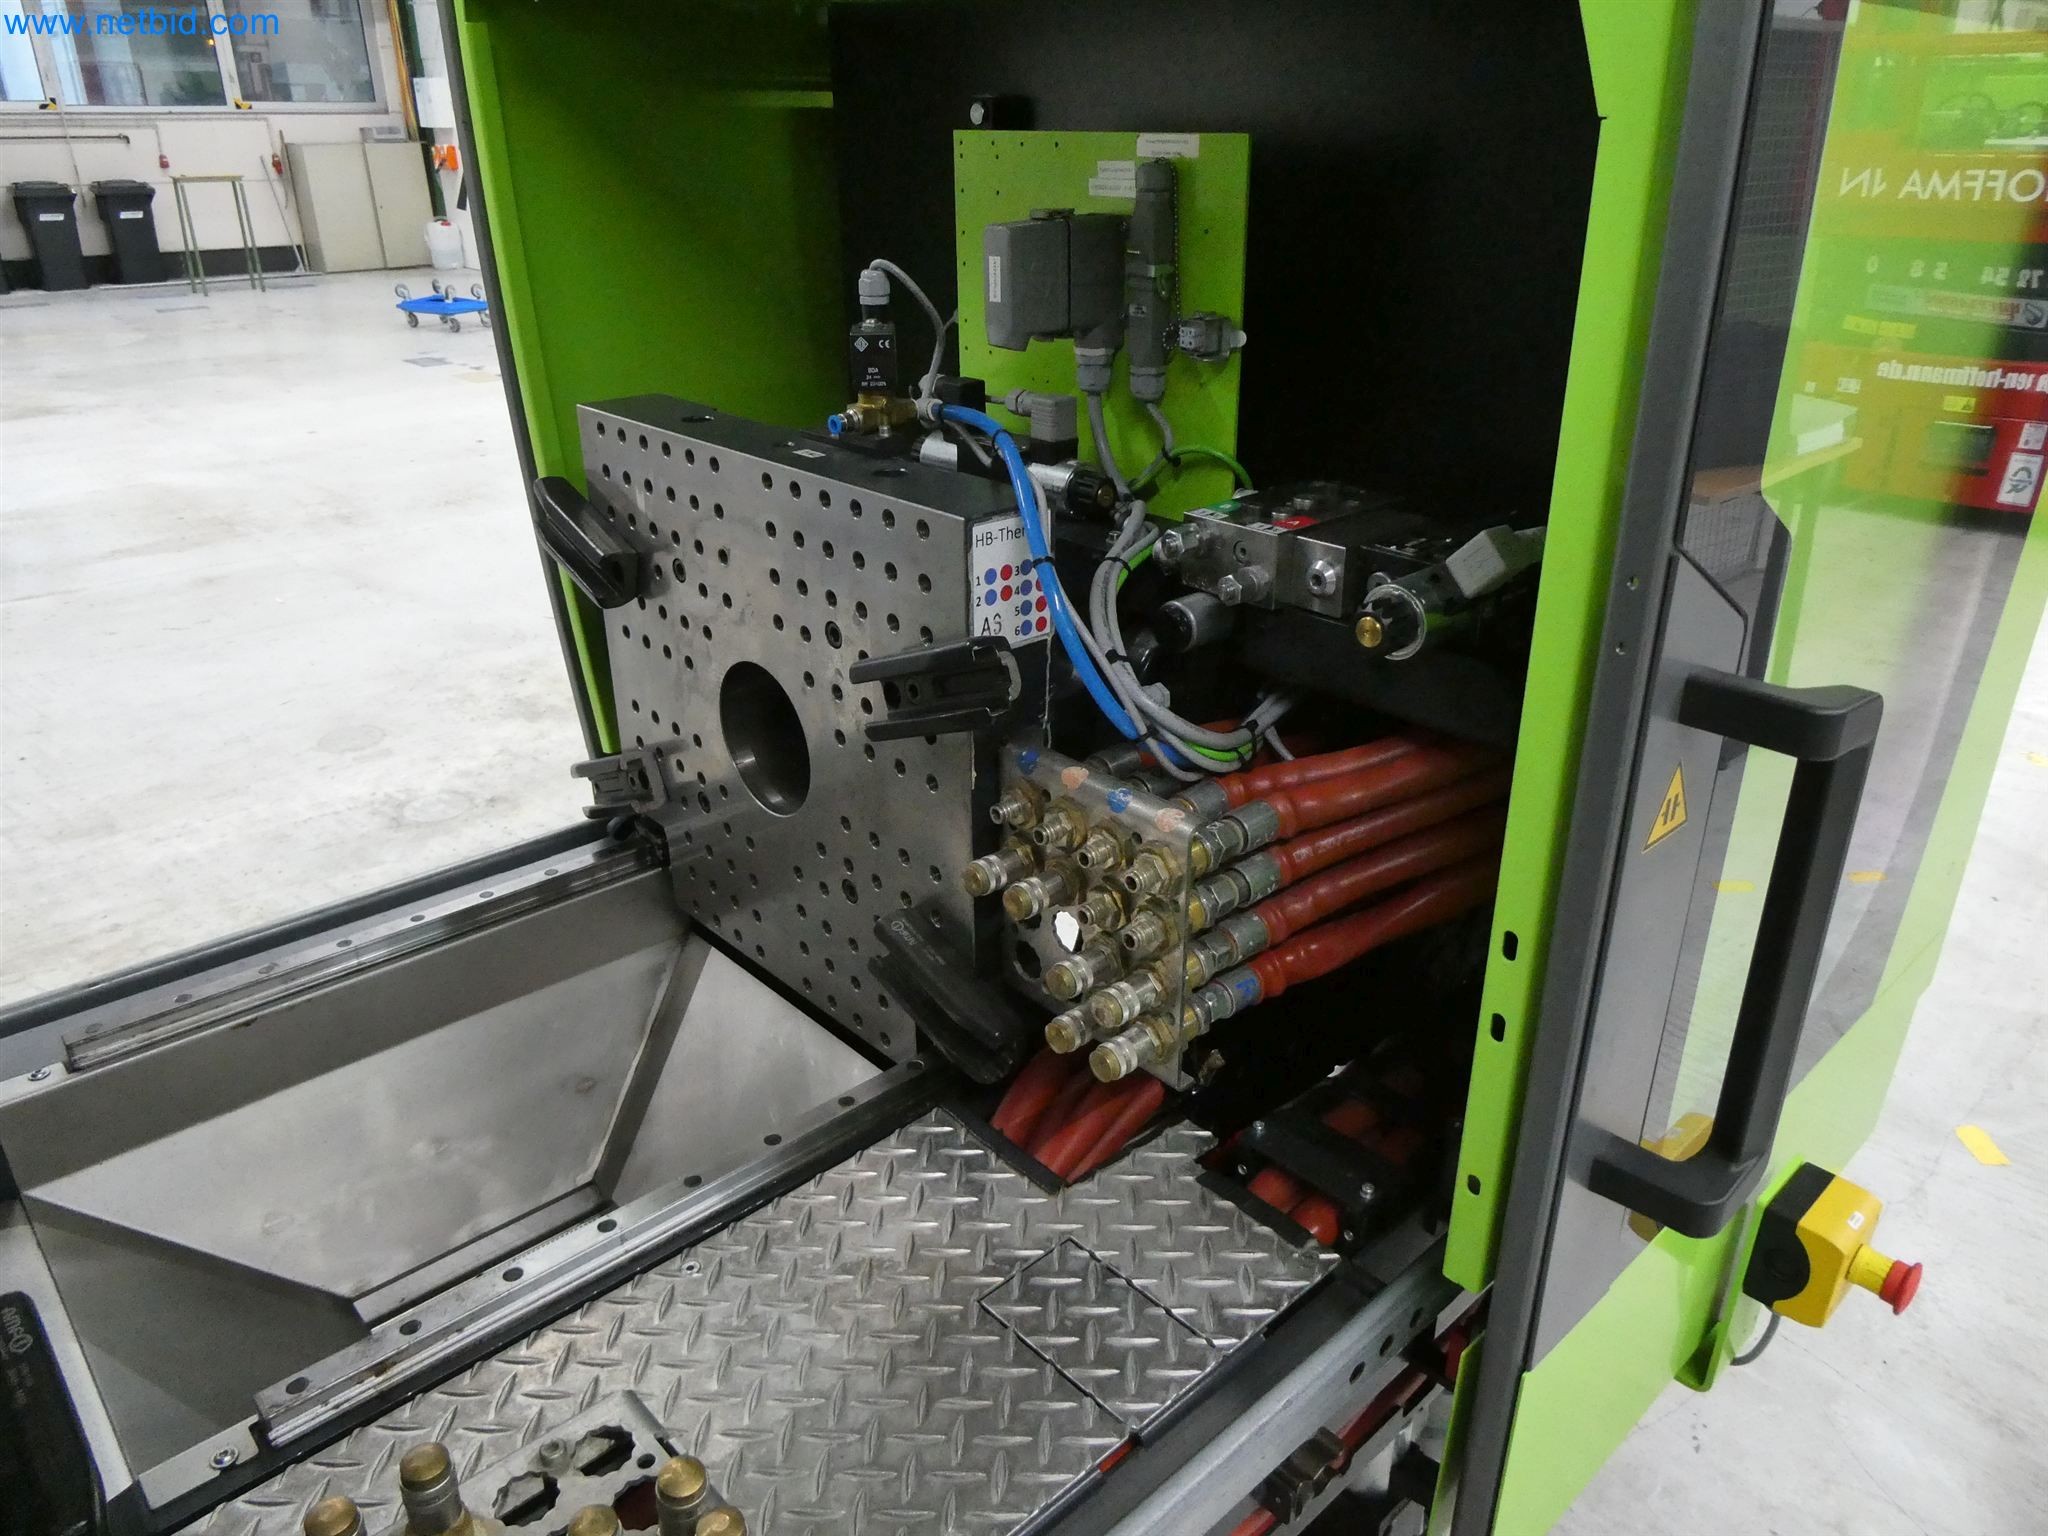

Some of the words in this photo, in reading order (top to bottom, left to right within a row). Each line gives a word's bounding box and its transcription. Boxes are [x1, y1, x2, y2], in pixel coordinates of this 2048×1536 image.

[1014, 565, 1020, 576] 3
[975, 576, 981, 586] 1
[1014, 585, 1020, 596] 4
[975, 597, 982, 607] 2
[1014, 606, 1020, 616] 5
[1014, 625, 1020, 636] 6
